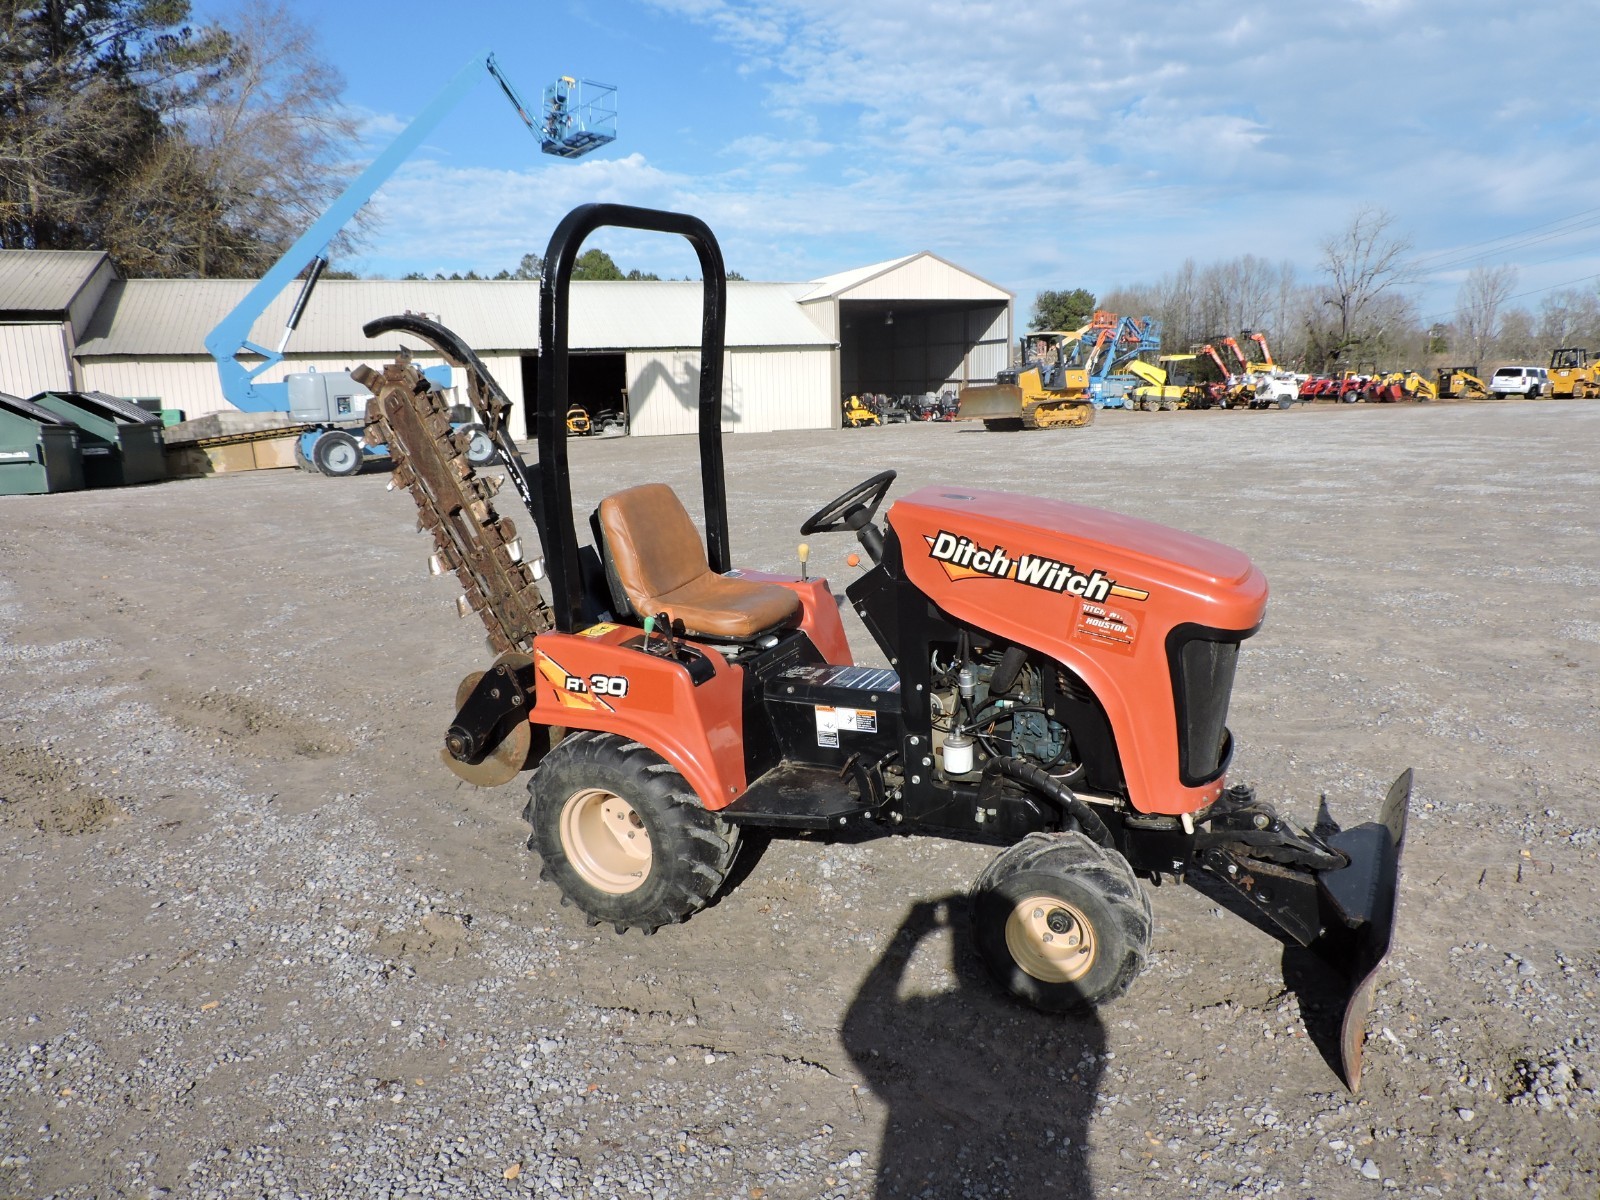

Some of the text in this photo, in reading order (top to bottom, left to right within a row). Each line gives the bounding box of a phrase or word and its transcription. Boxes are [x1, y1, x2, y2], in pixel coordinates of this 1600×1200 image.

[930, 530, 1112, 602] Ditch Witch
[1085, 617, 1128, 634] HOUSTON
